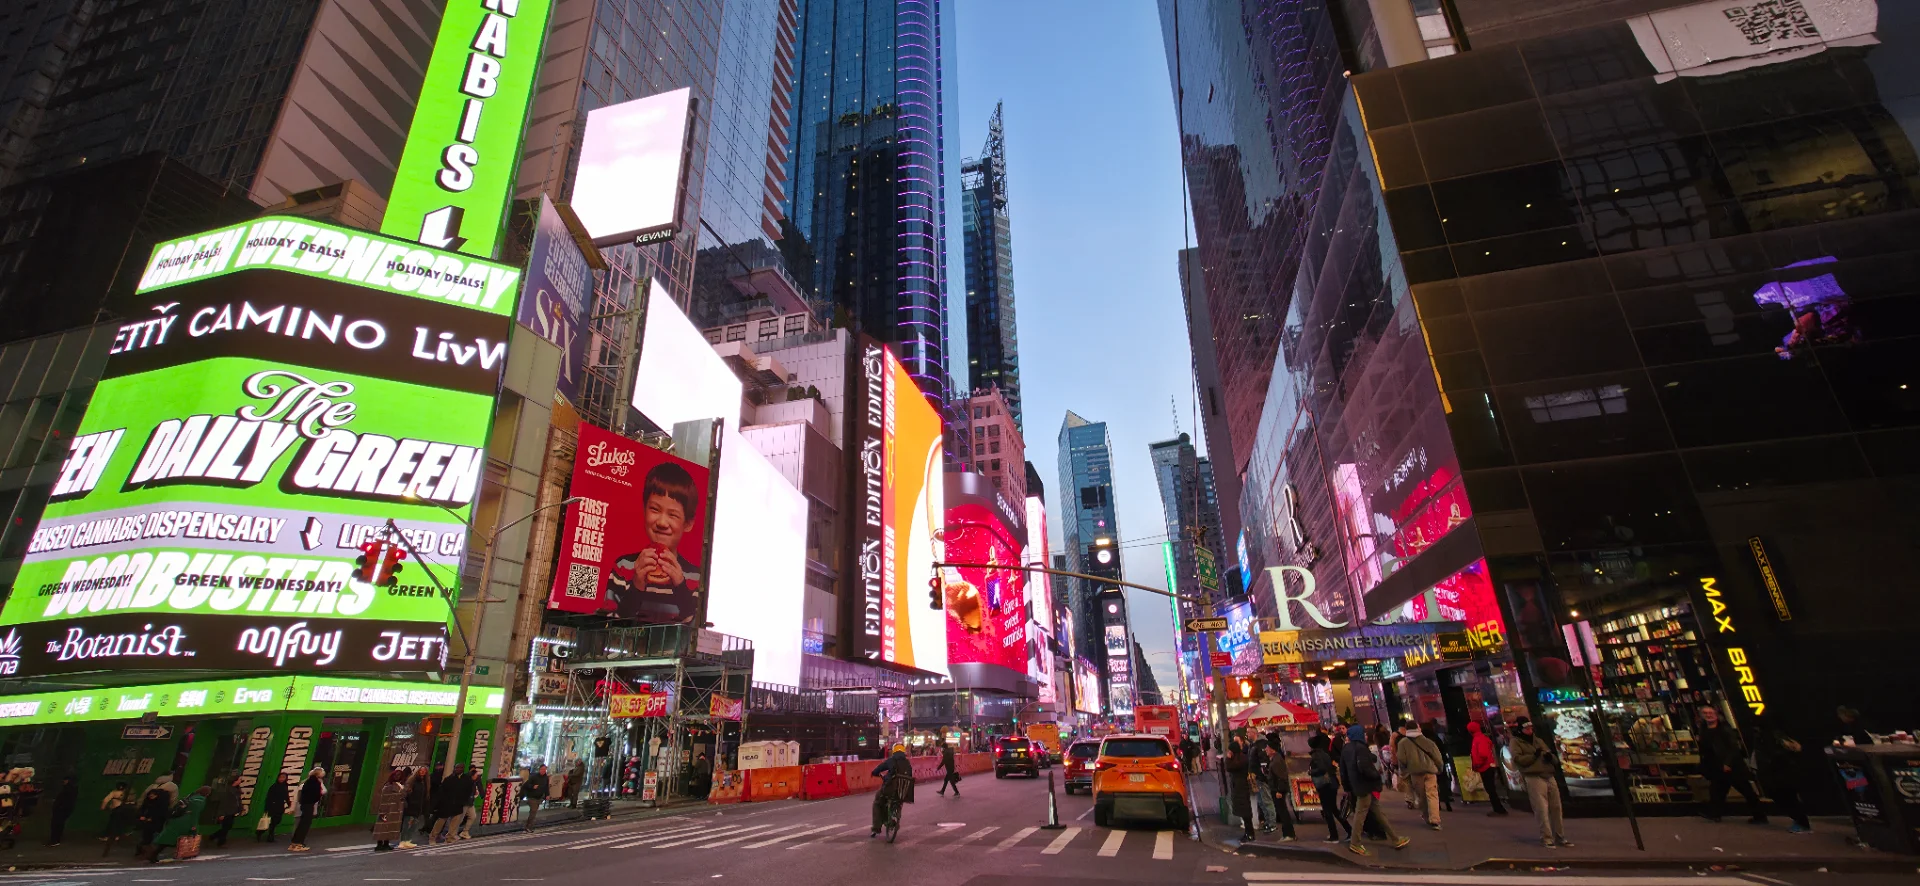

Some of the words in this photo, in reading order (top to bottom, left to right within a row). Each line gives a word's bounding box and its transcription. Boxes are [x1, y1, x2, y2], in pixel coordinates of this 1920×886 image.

[246, 234, 295, 249] HOLIDAY
[298, 239, 346, 259] DEALS!
[636, 229, 671, 244] KEVANI
[156, 252, 192, 270] HOLIDAY
[192, 246, 222, 262] DEALS!
[236, 219, 518, 308] WEDNESDAY
[387, 260, 441, 281] HOLIDAY
[443, 270, 486, 289] DEALS!
[189, 301, 386, 349] CAMINO
[867, 344, 882, 428] EDITION
[242, 370, 357, 439] The
[120, 414, 306, 492] DAILY
[279, 427, 485, 508] GREEN
[587, 441, 635, 467] Luka's
[866, 434, 881, 527] EDITION
[579, 497, 609, 516] FIRST
[27, 527, 72, 554] ENSED
[71, 513, 143, 549] CANNABIS
[144, 509, 287, 544] DISPENSARY
[578, 512, 607, 531] TIME?
[574, 527, 604, 547] FREE
[572, 543, 602, 563] SLIDER!
[39, 580, 70, 597] GREEN
[71, 574, 133, 594] WEDNESDAY!
[44, 552, 377, 619] DOORBUSTERS
[174, 572, 234, 588] GREEN
[238, 575, 342, 594] WEDNESDAY!
[865, 537, 881, 636] EDITION
[884, 525, 895, 620] HERSHEY'S
[1751, 539, 1768, 565] MAX
[1762, 564, 1789, 619] BRENNER
[387, 583, 436, 598] GREEN
[1264, 565, 1349, 631] R
[1700, 577, 1735, 633] MAX
[46, 640, 62, 654] The
[58, 624, 188, 662] Botanist
[1261, 635, 1363, 656] RENAISSANCE
[1403, 644, 1430, 668] MAX
[647, 696, 666, 712] OFF
